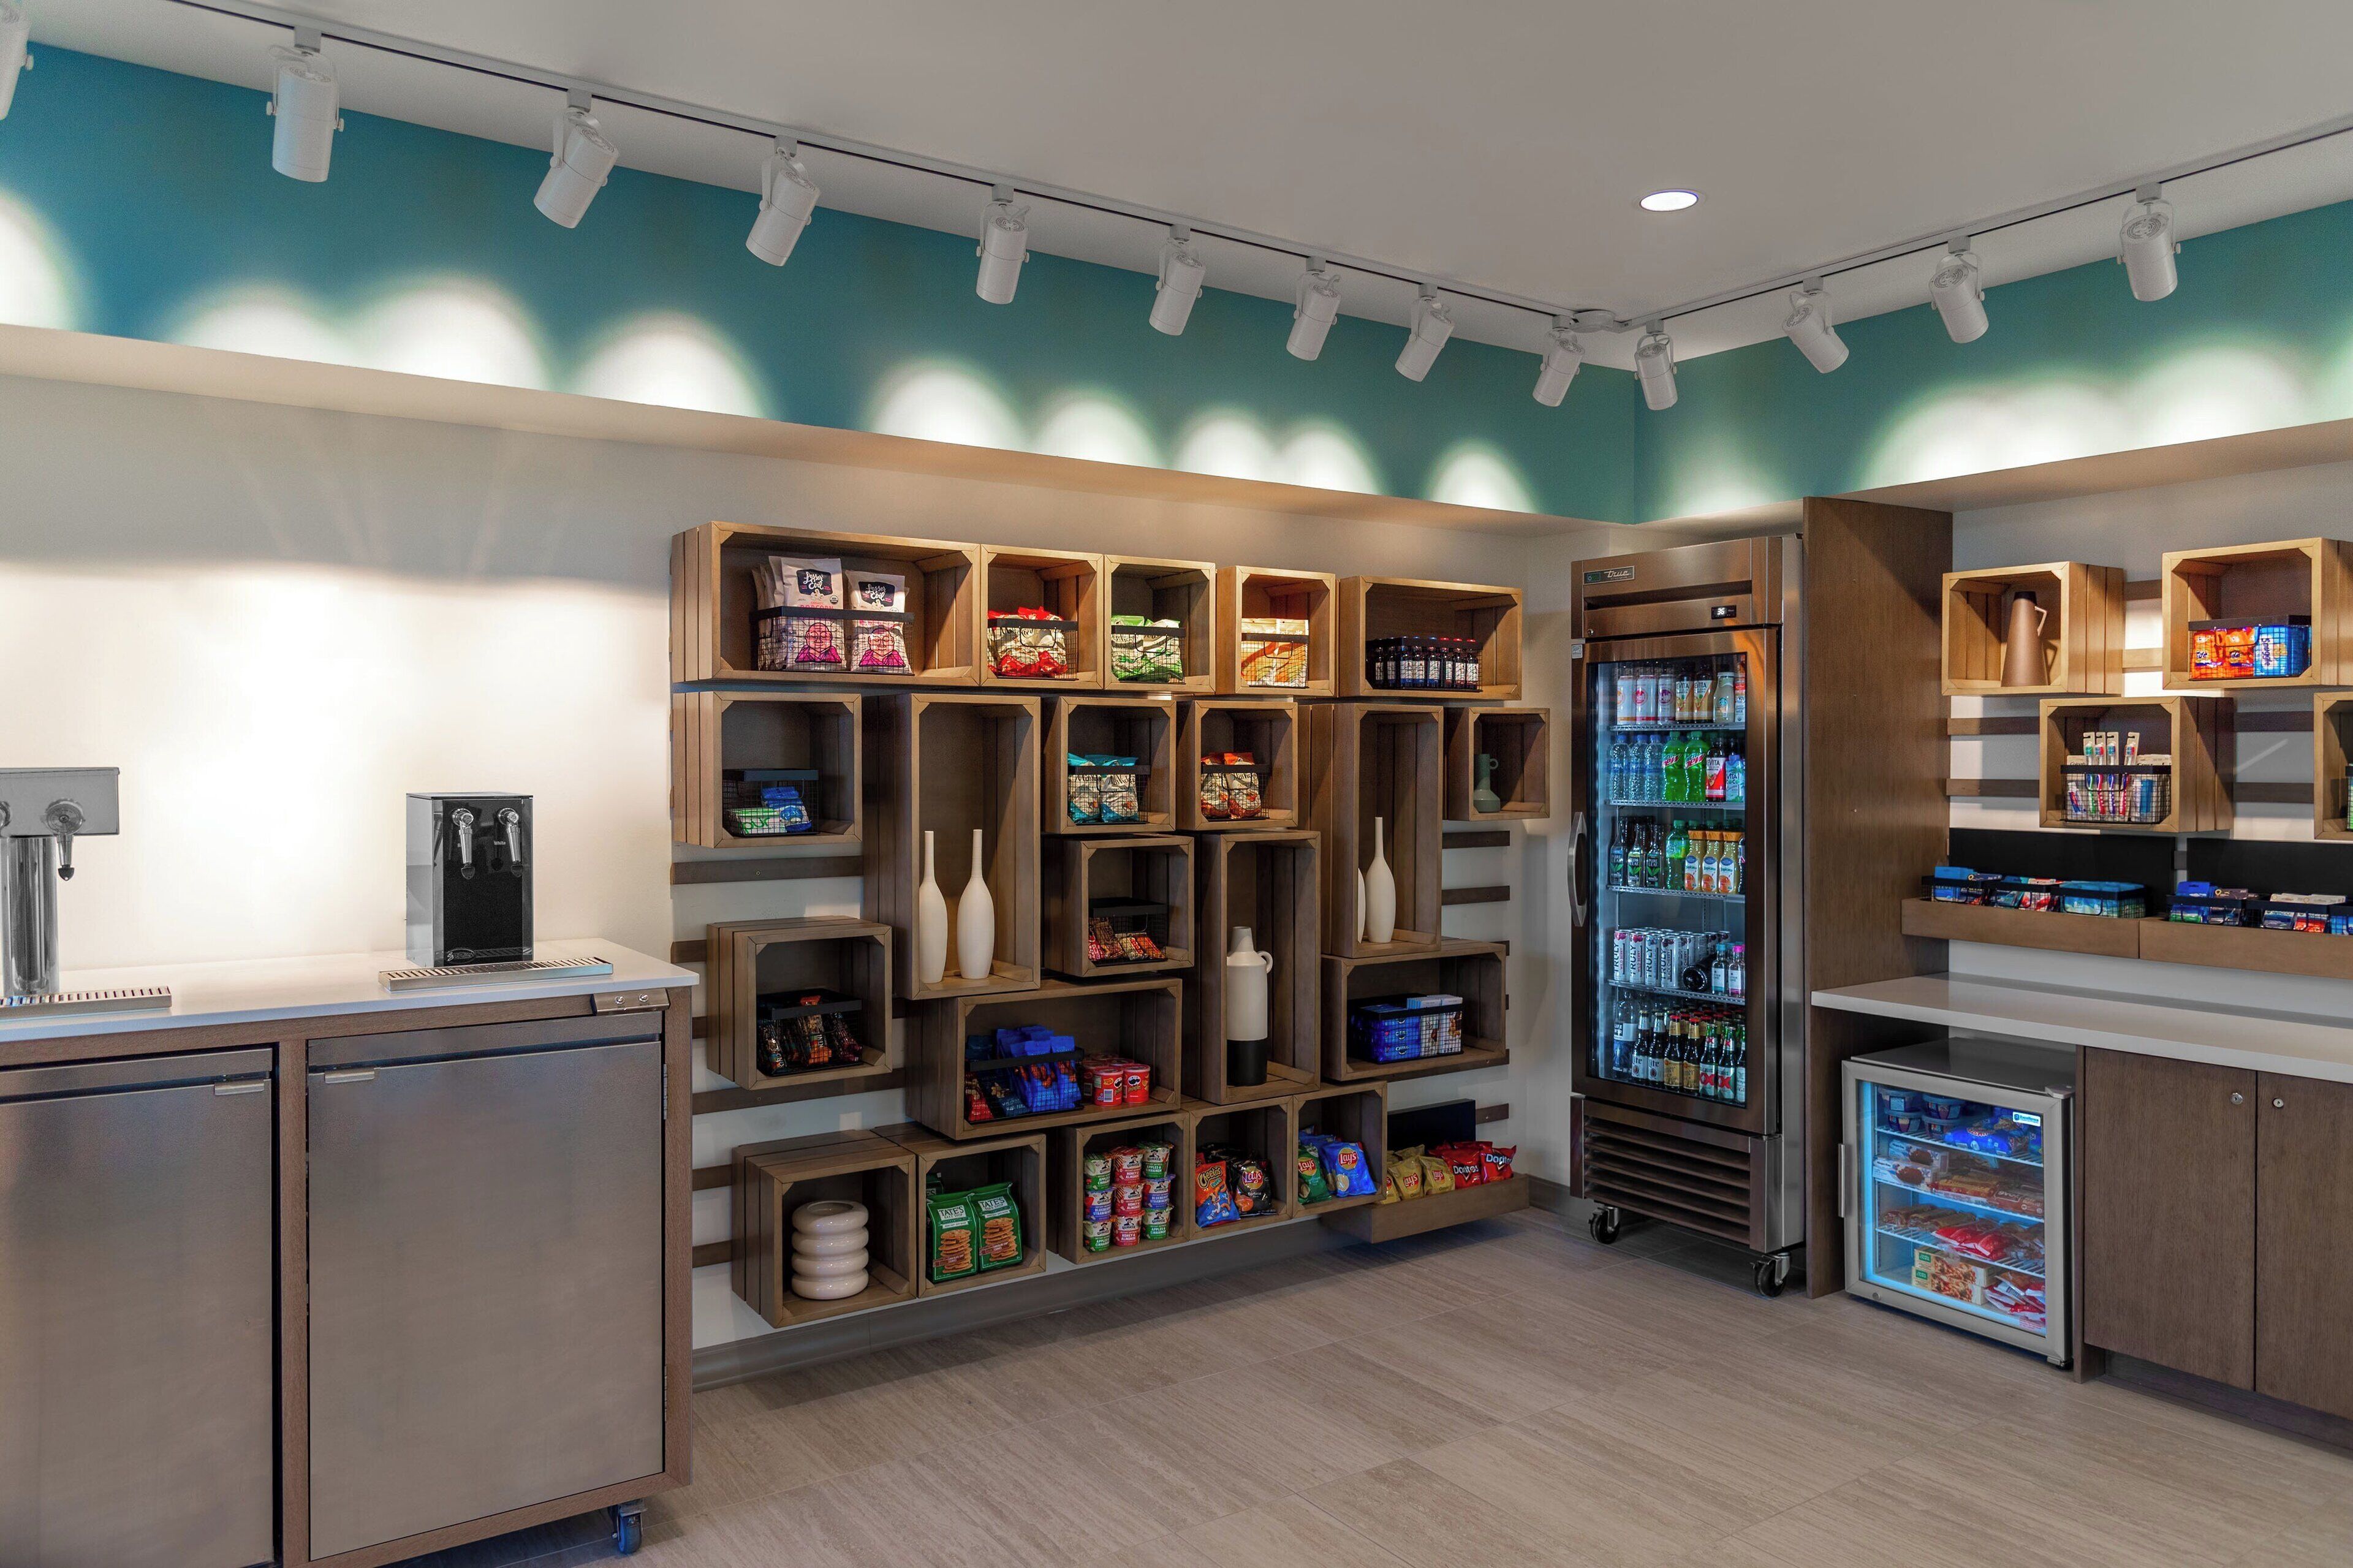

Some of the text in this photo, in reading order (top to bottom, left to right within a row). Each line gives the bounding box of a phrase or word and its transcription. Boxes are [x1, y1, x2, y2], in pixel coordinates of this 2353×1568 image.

[803, 572, 824, 584] Lesser
[808, 581, 824, 590] Evil
[865, 584, 886, 594] Lesser
[870, 592, 885, 601] Evil
[2261, 637, 2270, 666] Snuggle
[776, 1053, 784, 1067] KIND
[1128, 1085, 1140, 1093] Pringles
[1340, 1152, 1357, 1165] Lay's
[1453, 1164, 1479, 1175] Doritos
[1199, 1165, 1222, 1188] Cheetos
[1243, 1171, 1262, 1184] Lay's
[980, 1197, 1006, 1208] TATE'S
[939, 1206, 964, 1217] TATE'S
